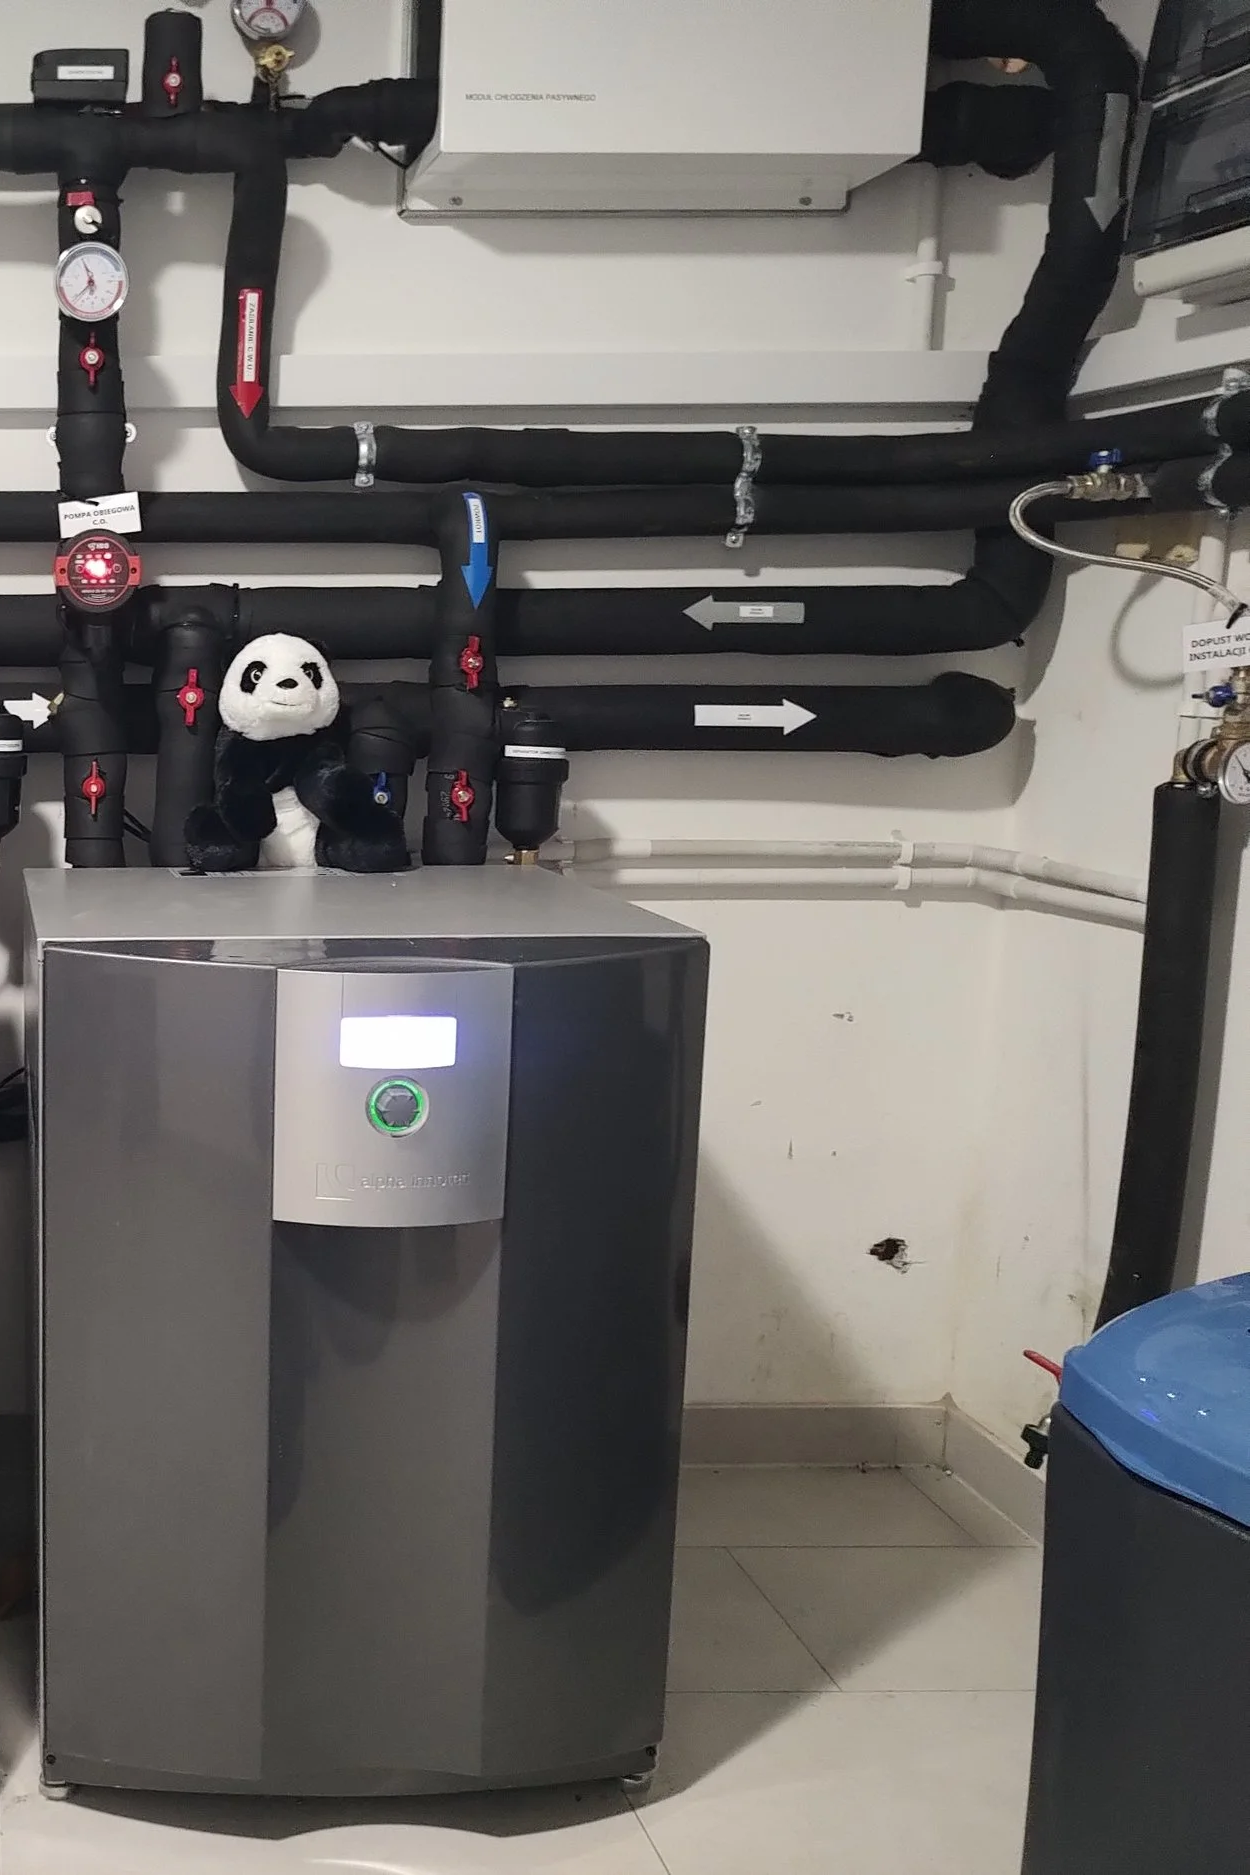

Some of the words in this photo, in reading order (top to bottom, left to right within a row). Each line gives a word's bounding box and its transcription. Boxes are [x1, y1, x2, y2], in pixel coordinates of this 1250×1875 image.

[545, 93, 597, 102] PASYWNEGO
[63, 511, 92, 520] POMPA
[93, 504, 136, 517] OBIEGOWA
[92, 518, 108, 526] C.O.
[1191, 635, 1232, 648] DOPUST
[1189, 647, 1246, 661] INSTALACJI
[361, 1173, 406, 1192] alpha
